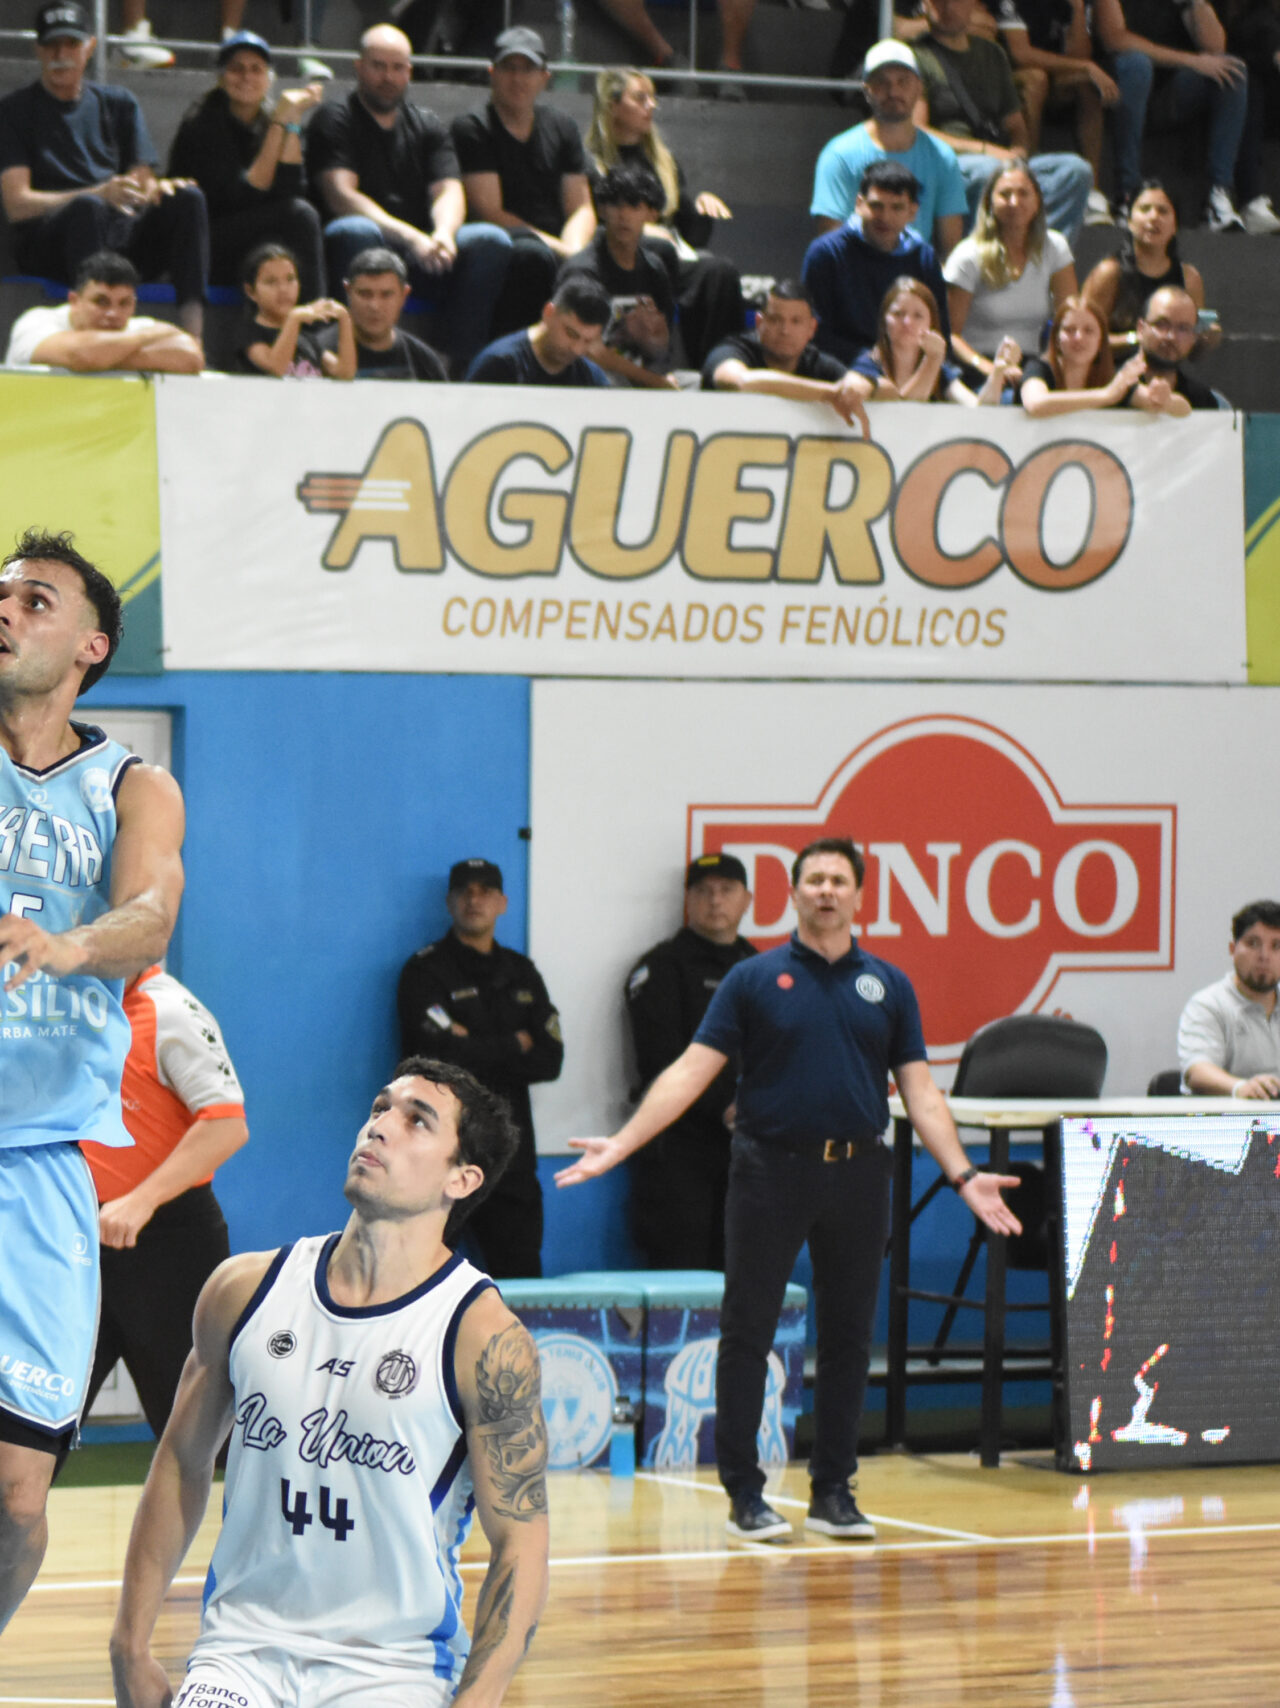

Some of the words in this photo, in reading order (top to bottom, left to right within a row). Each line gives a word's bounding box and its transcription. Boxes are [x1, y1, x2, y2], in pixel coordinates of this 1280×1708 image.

[320, 416, 1135, 593] AGUERCO
[442, 596, 764, 644] COMPENSADOS
[780, 596, 1008, 648] FENÓLICOS
[721, 839, 1141, 939] DNCO
[37, 1025, 78, 1037] MATE
[235, 1392, 288, 1452] La
[299, 1407, 416, 1476] Union
[281, 1477, 355, 1542] 44
[195, 1683, 249, 1707] Banco
